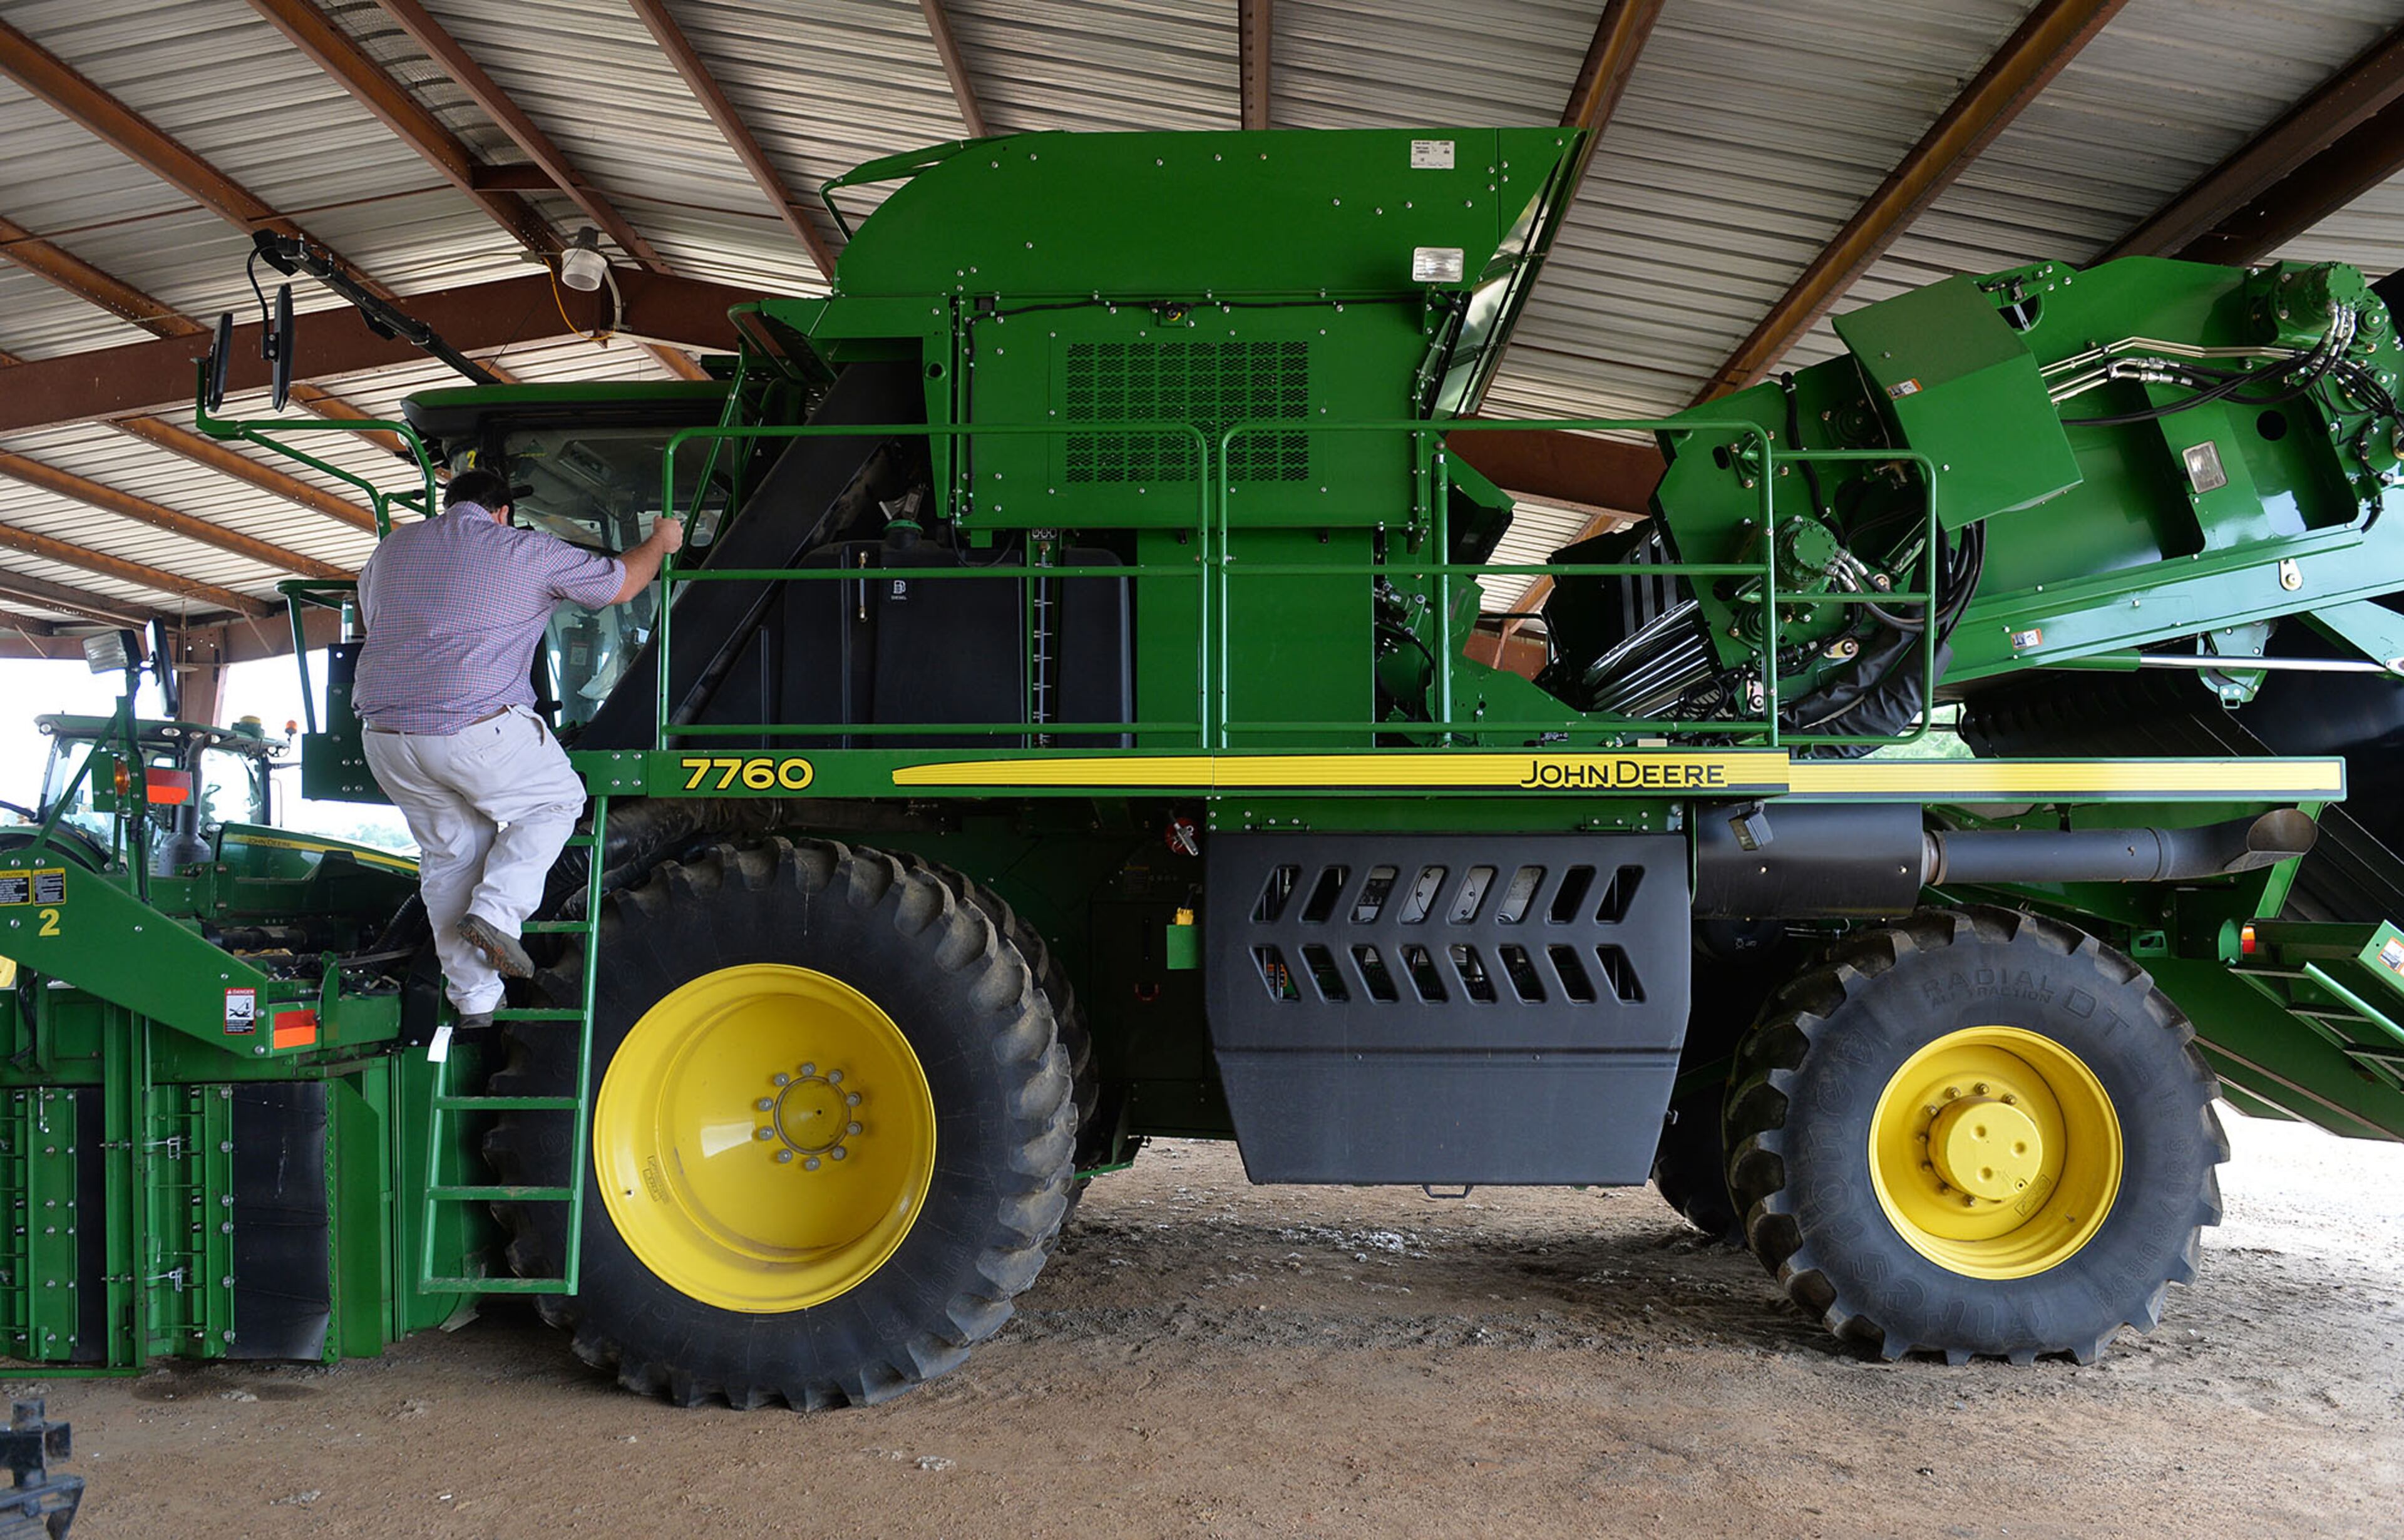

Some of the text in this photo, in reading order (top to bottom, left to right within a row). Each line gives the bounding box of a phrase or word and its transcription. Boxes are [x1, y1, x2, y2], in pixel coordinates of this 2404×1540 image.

[681, 757, 815, 792] 7760
[39, 908, 60, 937] 2
[1922, 967, 2055, 1000] RADIAL
